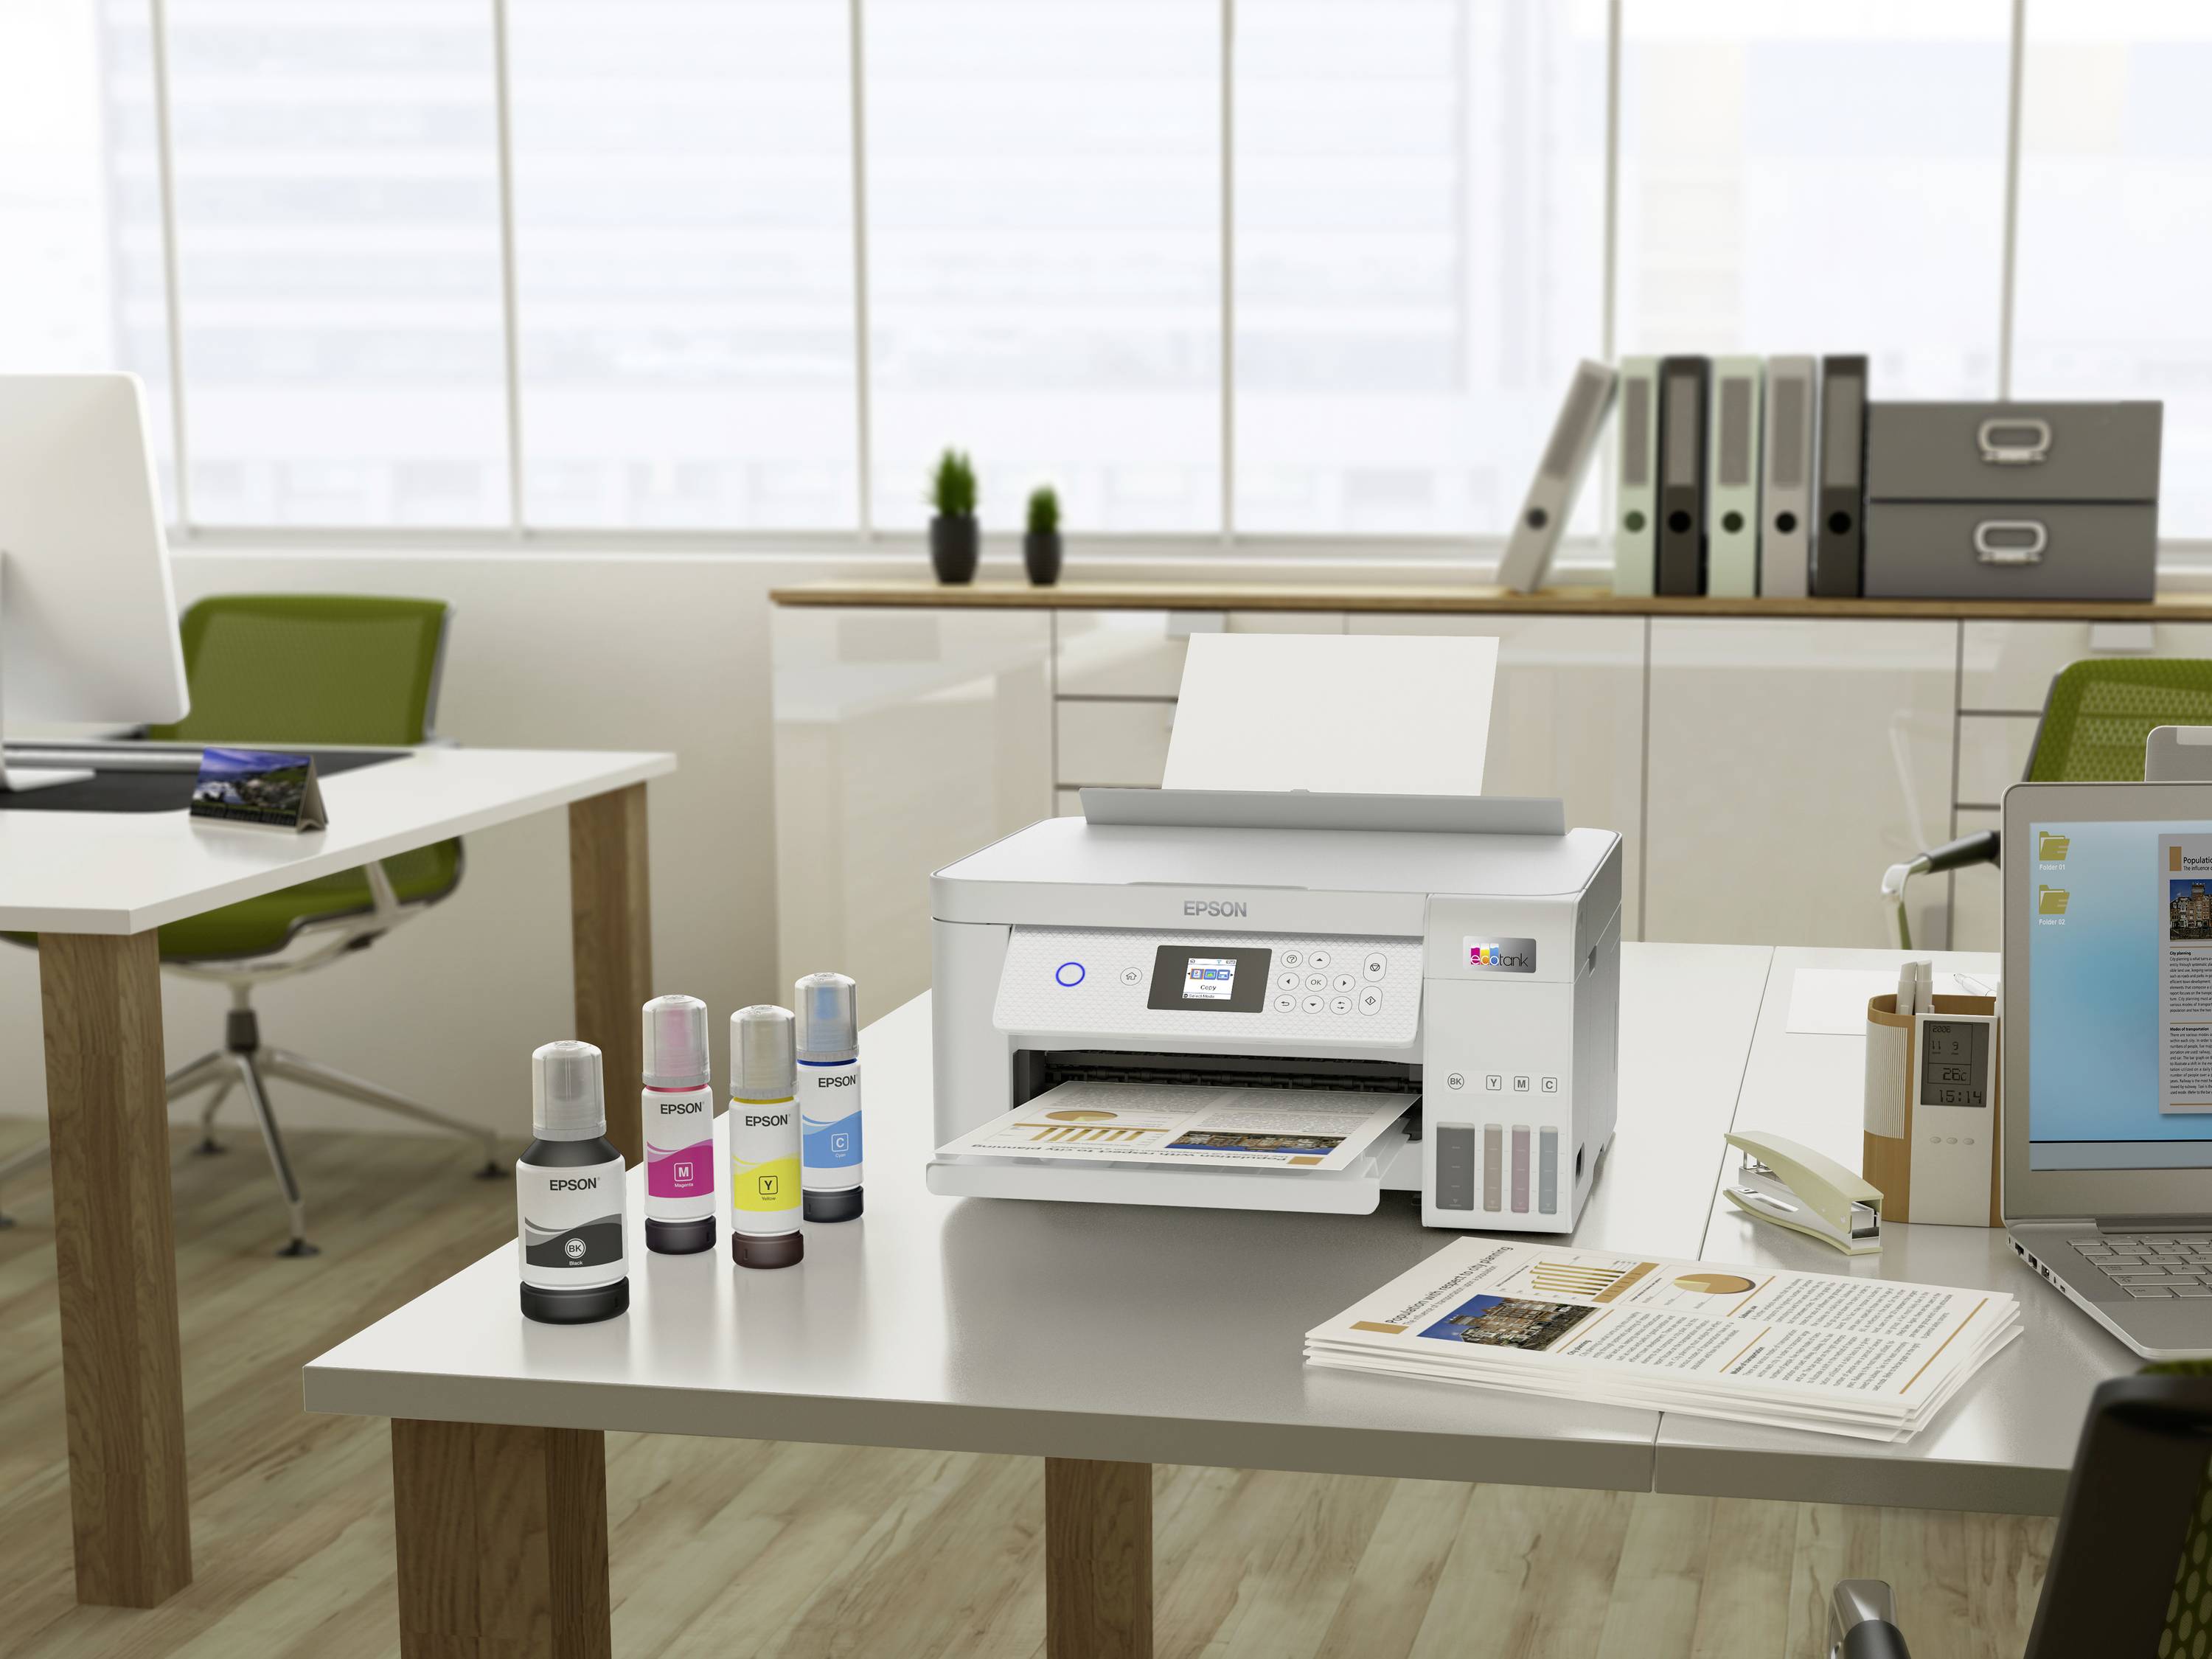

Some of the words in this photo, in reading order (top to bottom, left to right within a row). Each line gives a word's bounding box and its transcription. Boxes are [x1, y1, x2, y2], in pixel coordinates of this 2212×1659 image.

[1183, 900, 1247, 917] EPSON
[1470, 953, 1528, 967] ecotank
[818, 1074, 856, 1088] EPSON
[1450, 1077, 1462, 1085] BK
[1490, 1079, 1498, 1088] Y
[1517, 1079, 1526, 1088] M
[1545, 1080, 1553, 1089] C
[1939, 1090, 1982, 1104] 15:14
[660, 1101, 702, 1114] EPSON
[745, 1114, 788, 1127] EPSON
[835, 1138, 844, 1148] C
[678, 1166, 689, 1178] M
[549, 1178, 597, 1191] EPSON
[764, 1180, 773, 1190] Y
[568, 1245, 582, 1253] BK
[1385, 1301, 1428, 1324] Population
[1423, 1291, 1444, 1300] with
[1439, 1276, 1467, 1290] respect
[1480, 1247, 1513, 1264] planning
